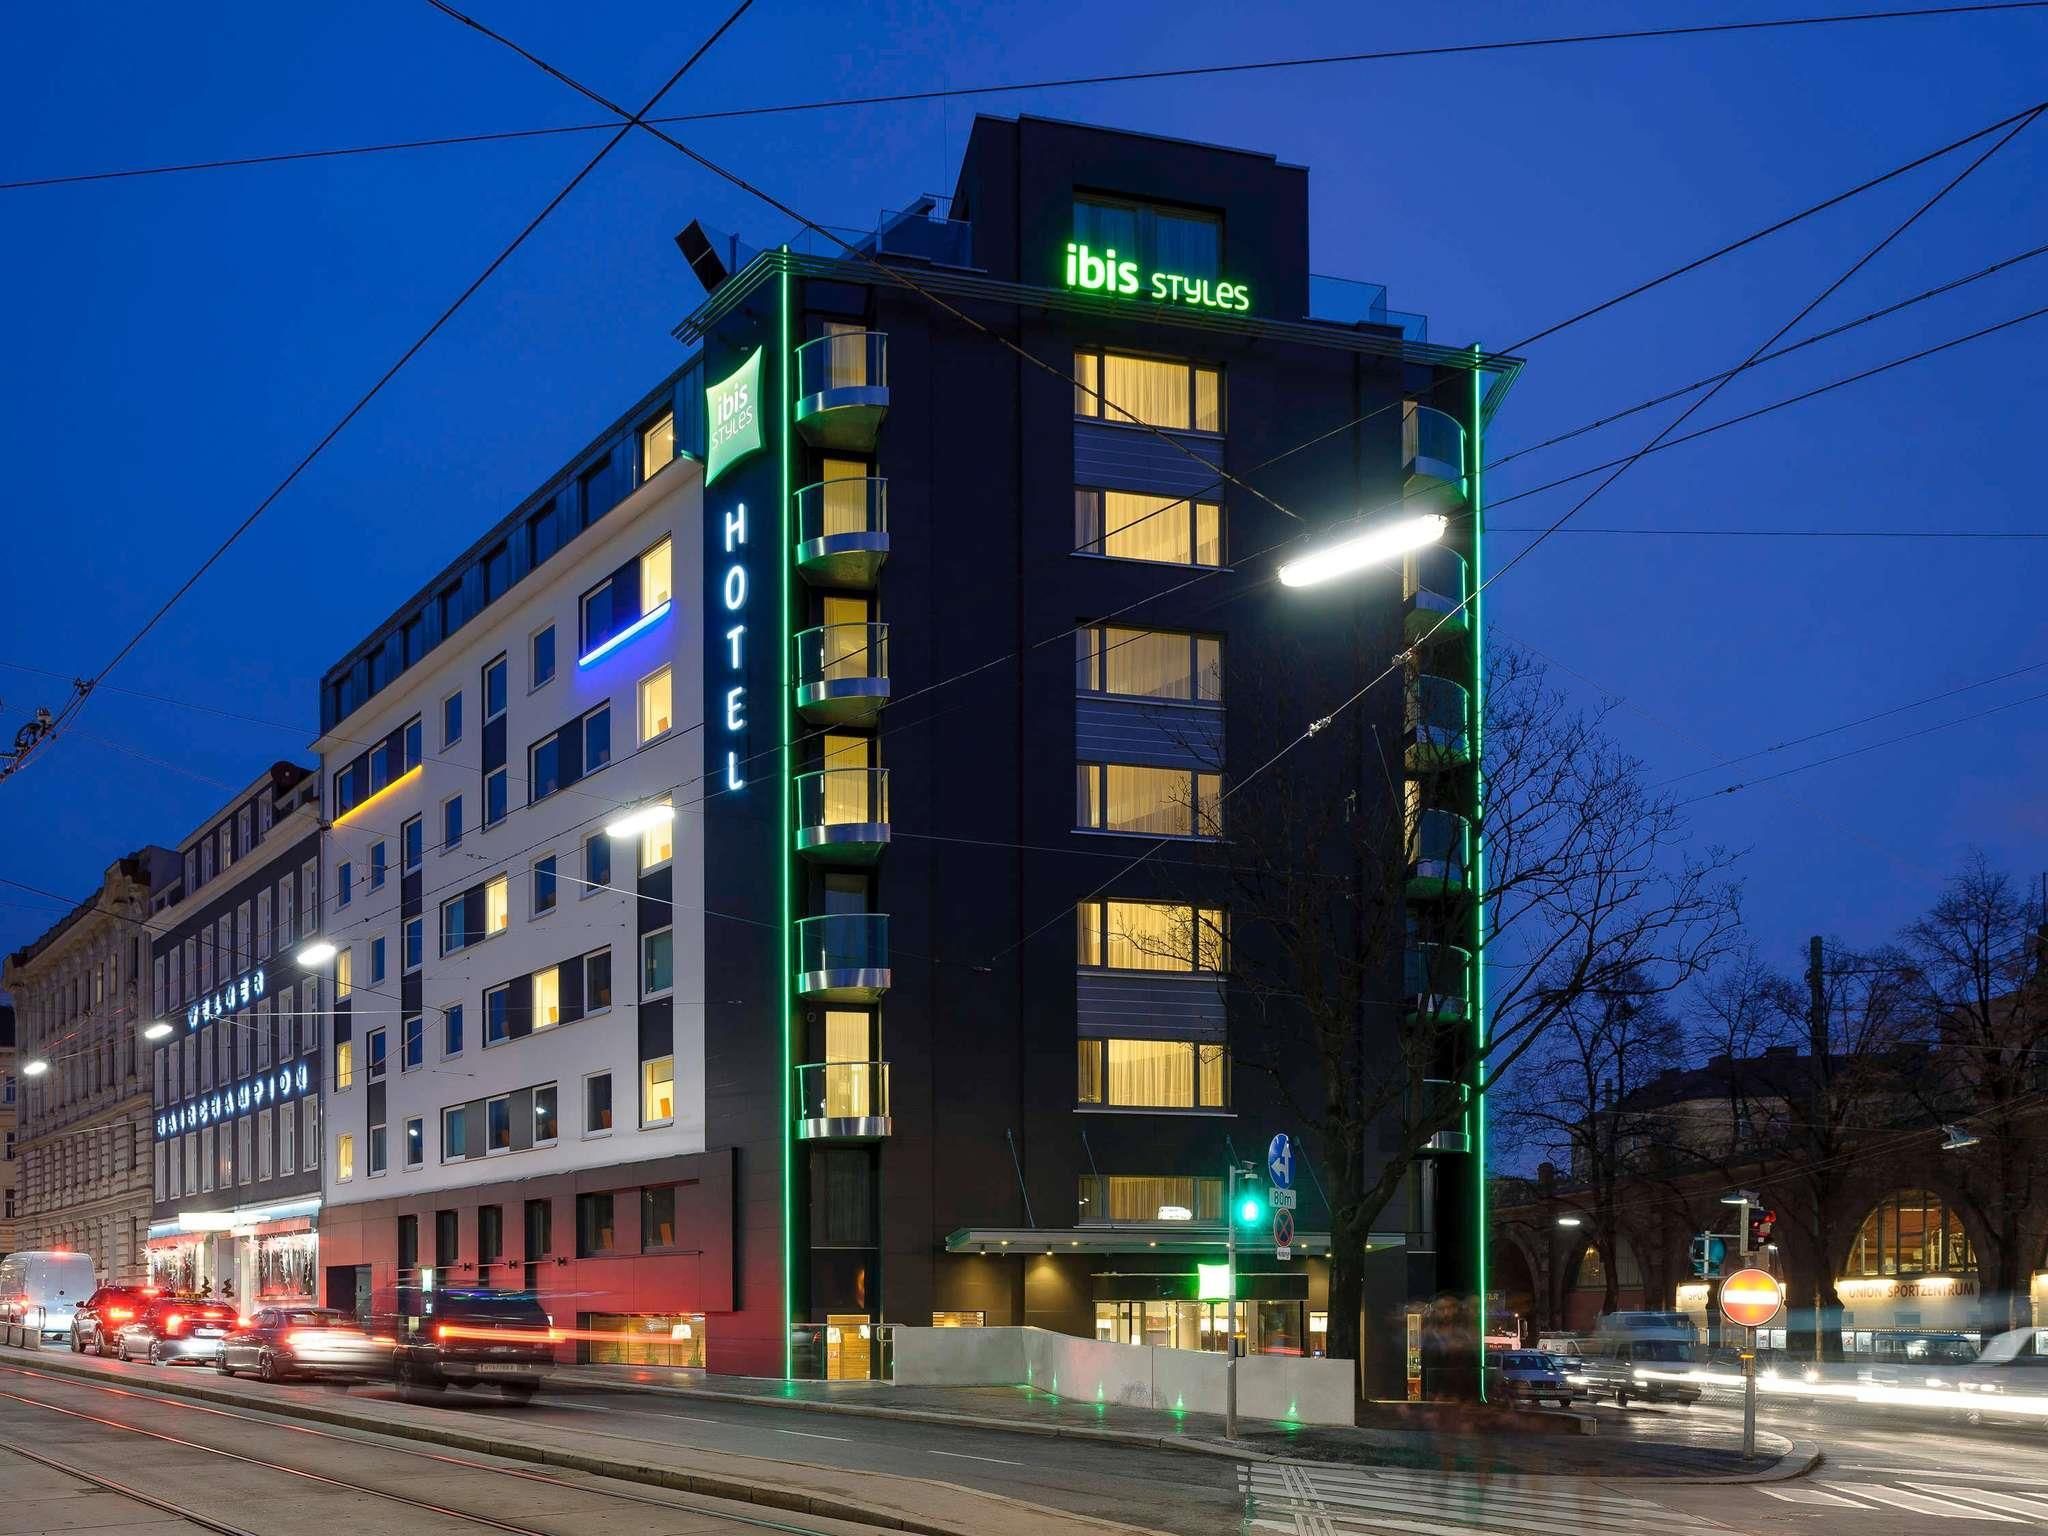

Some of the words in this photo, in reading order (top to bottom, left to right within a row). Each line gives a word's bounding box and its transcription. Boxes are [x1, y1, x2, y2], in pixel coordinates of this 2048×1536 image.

[1066, 242, 1139, 294] ibis
[717, 382, 749, 425] ibis
[725, 502, 747, 790] HOTEL
[157, 1064, 308, 1136] HAIRCHAMPION
[1849, 1285, 1882, 1299] UNION
[1887, 1282, 1975, 1298] SPORTZENTRUM
